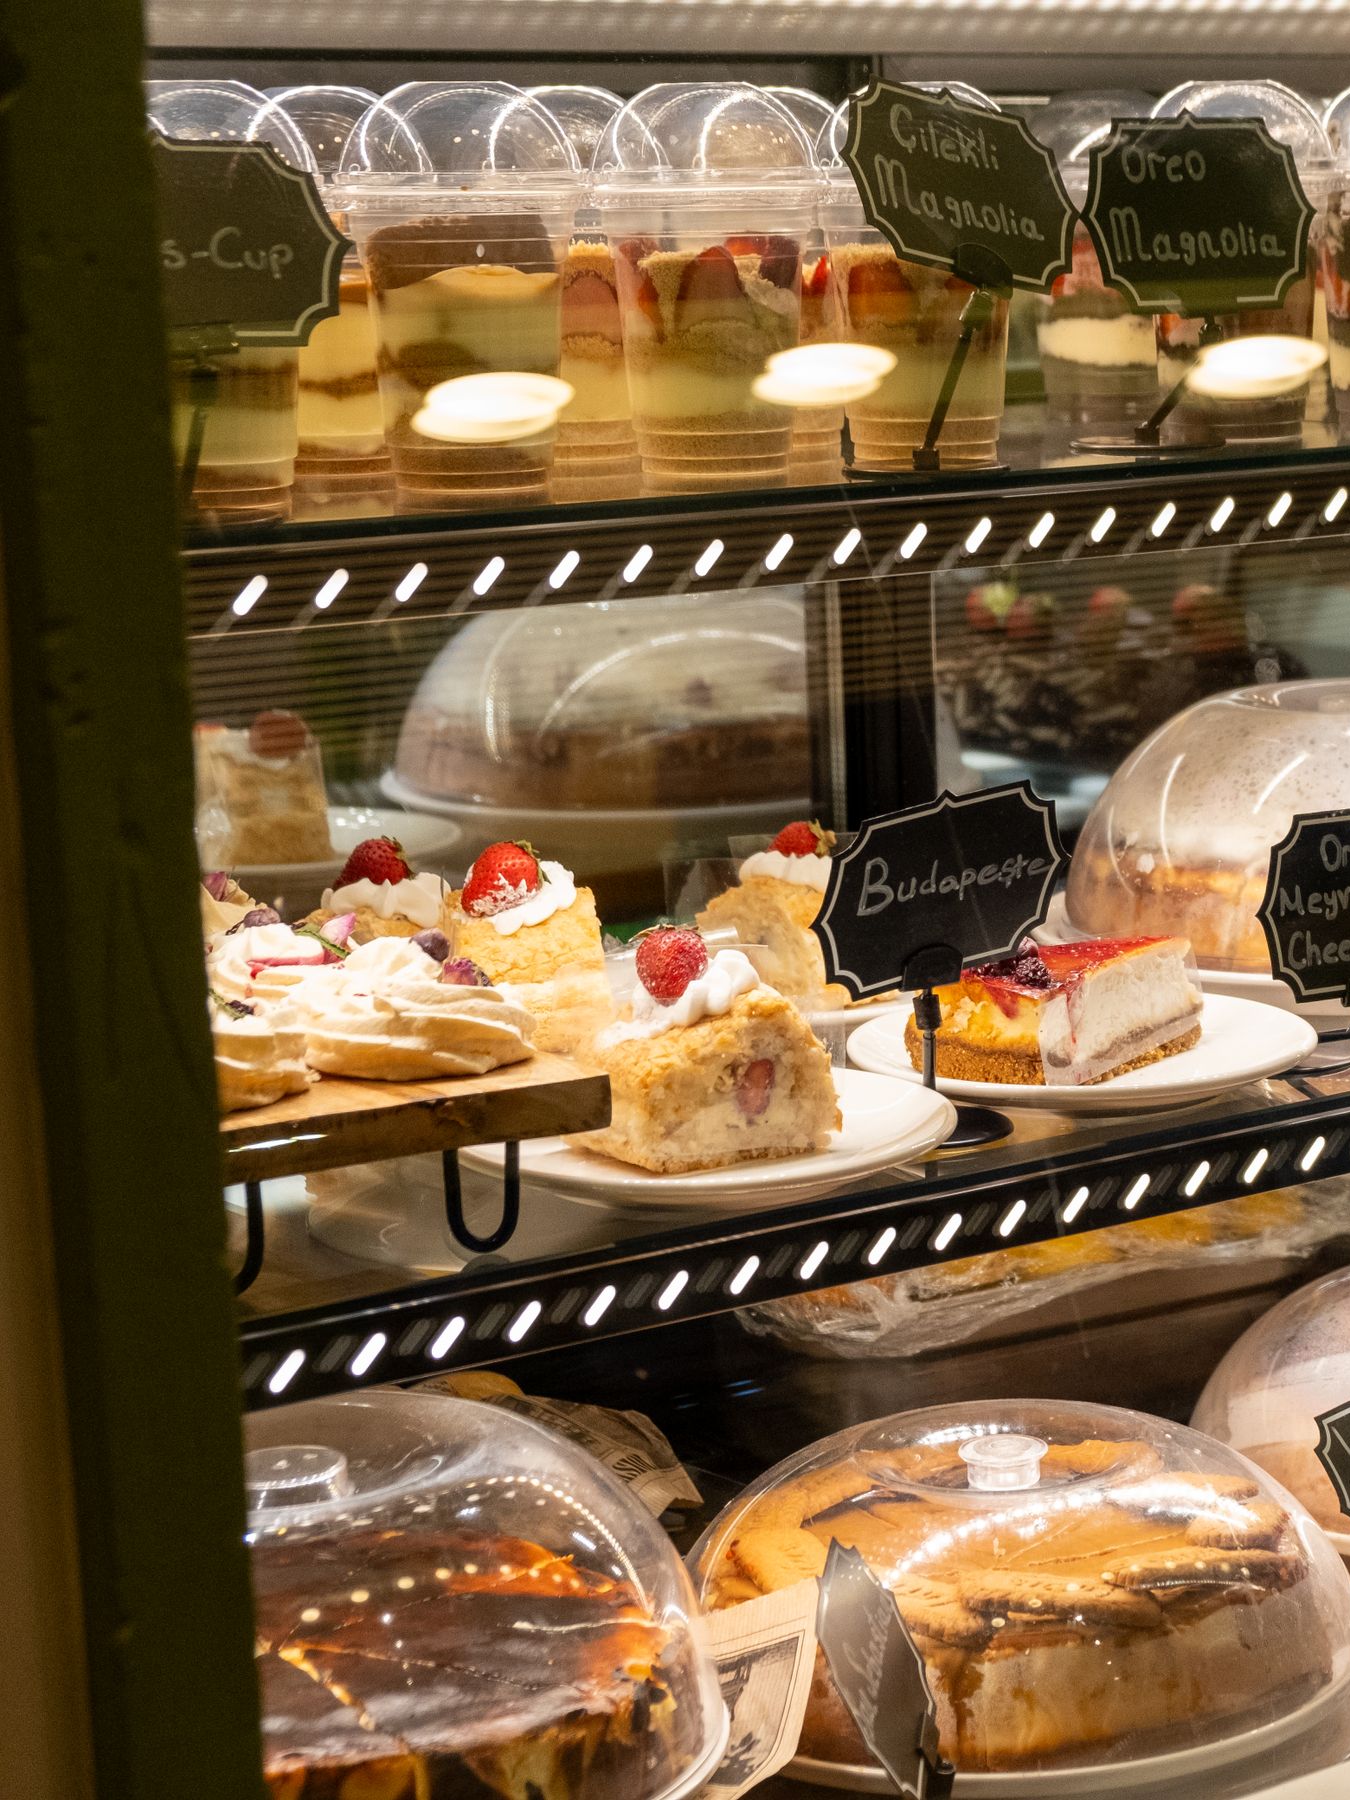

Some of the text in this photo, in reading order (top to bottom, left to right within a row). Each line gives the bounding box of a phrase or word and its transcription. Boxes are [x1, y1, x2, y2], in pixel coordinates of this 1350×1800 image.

[890, 103, 999, 170] Çilekli
[1121, 145, 1206, 184] Oreo
[874, 152, 1045, 241] Magnolia
[1109, 206, 1286, 266] Magnolia
[856, 853, 1050, 916] Budapeşte
